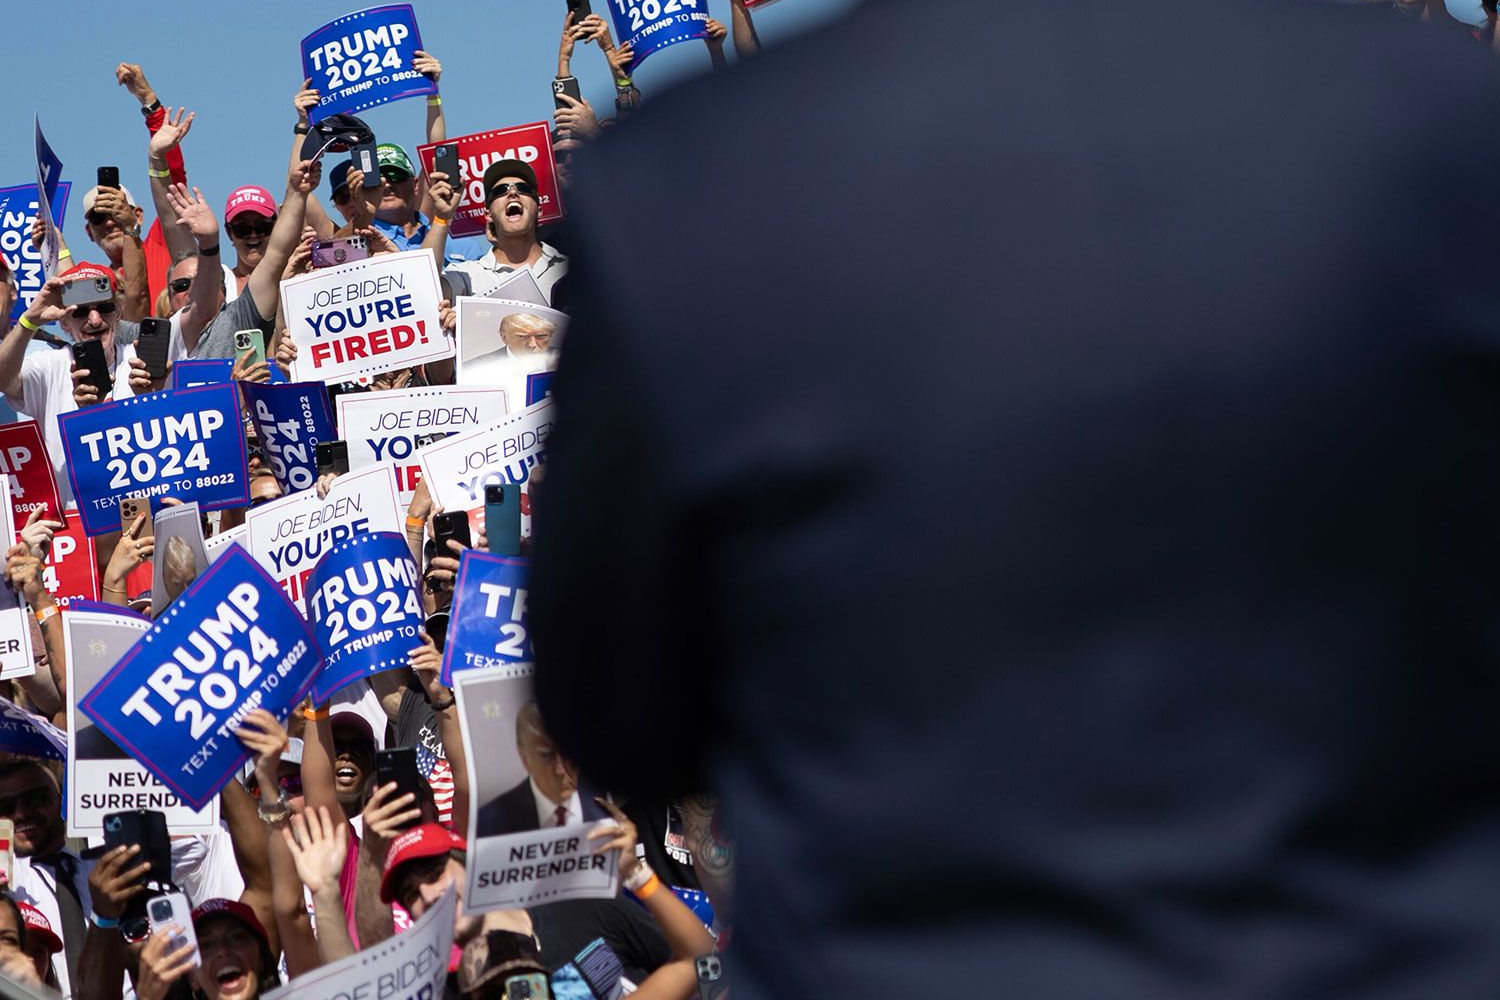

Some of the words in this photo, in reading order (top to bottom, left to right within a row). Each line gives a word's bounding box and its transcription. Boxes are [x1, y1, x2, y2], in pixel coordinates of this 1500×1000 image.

[310, 23, 409, 71] TRUMP
[641, 16, 674, 39] TRUMP
[675, 12, 690, 23] TO
[325, 47, 402, 90] 2024
[339, 81, 373, 99] TRUMP
[375, 75, 390, 86] TO
[306, 283, 344, 310] JOE
[345, 272, 407, 303] BIDEN,
[305, 294, 415, 338] YOU'RE
[310, 320, 429, 369] FIRED!
[301, 395, 316, 433] 88022
[370, 412, 413, 432] JOE
[416, 406, 480, 426] BIDEN,
[80, 409, 224, 463] TRUMP
[106, 442, 210, 490] 2024
[457, 450, 498, 476] JOE
[92, 495, 122, 510] TEXT
[125, 484, 171, 500] TRUMP
[173, 479, 192, 491] TO
[195, 472, 235, 488] 88022
[270, 513, 307, 543] JOE
[308, 493, 363, 529] BIDEN,
[311, 558, 419, 623] TRUMP
[325, 591, 422, 647] 2024
[343, 630, 394, 655] TRUMP
[396, 625, 415, 639] TO
[120, 582, 260, 727] TRUMP
[174, 625, 279, 741] 2024
[181, 738, 220, 776] TEXT
[217, 689, 264, 738] TRUMP
[261, 672, 280, 694] TO
[278, 640, 308, 677] 88022
[477, 853, 607, 889] SURRENDER
[509, 837, 579, 863] NEVER
